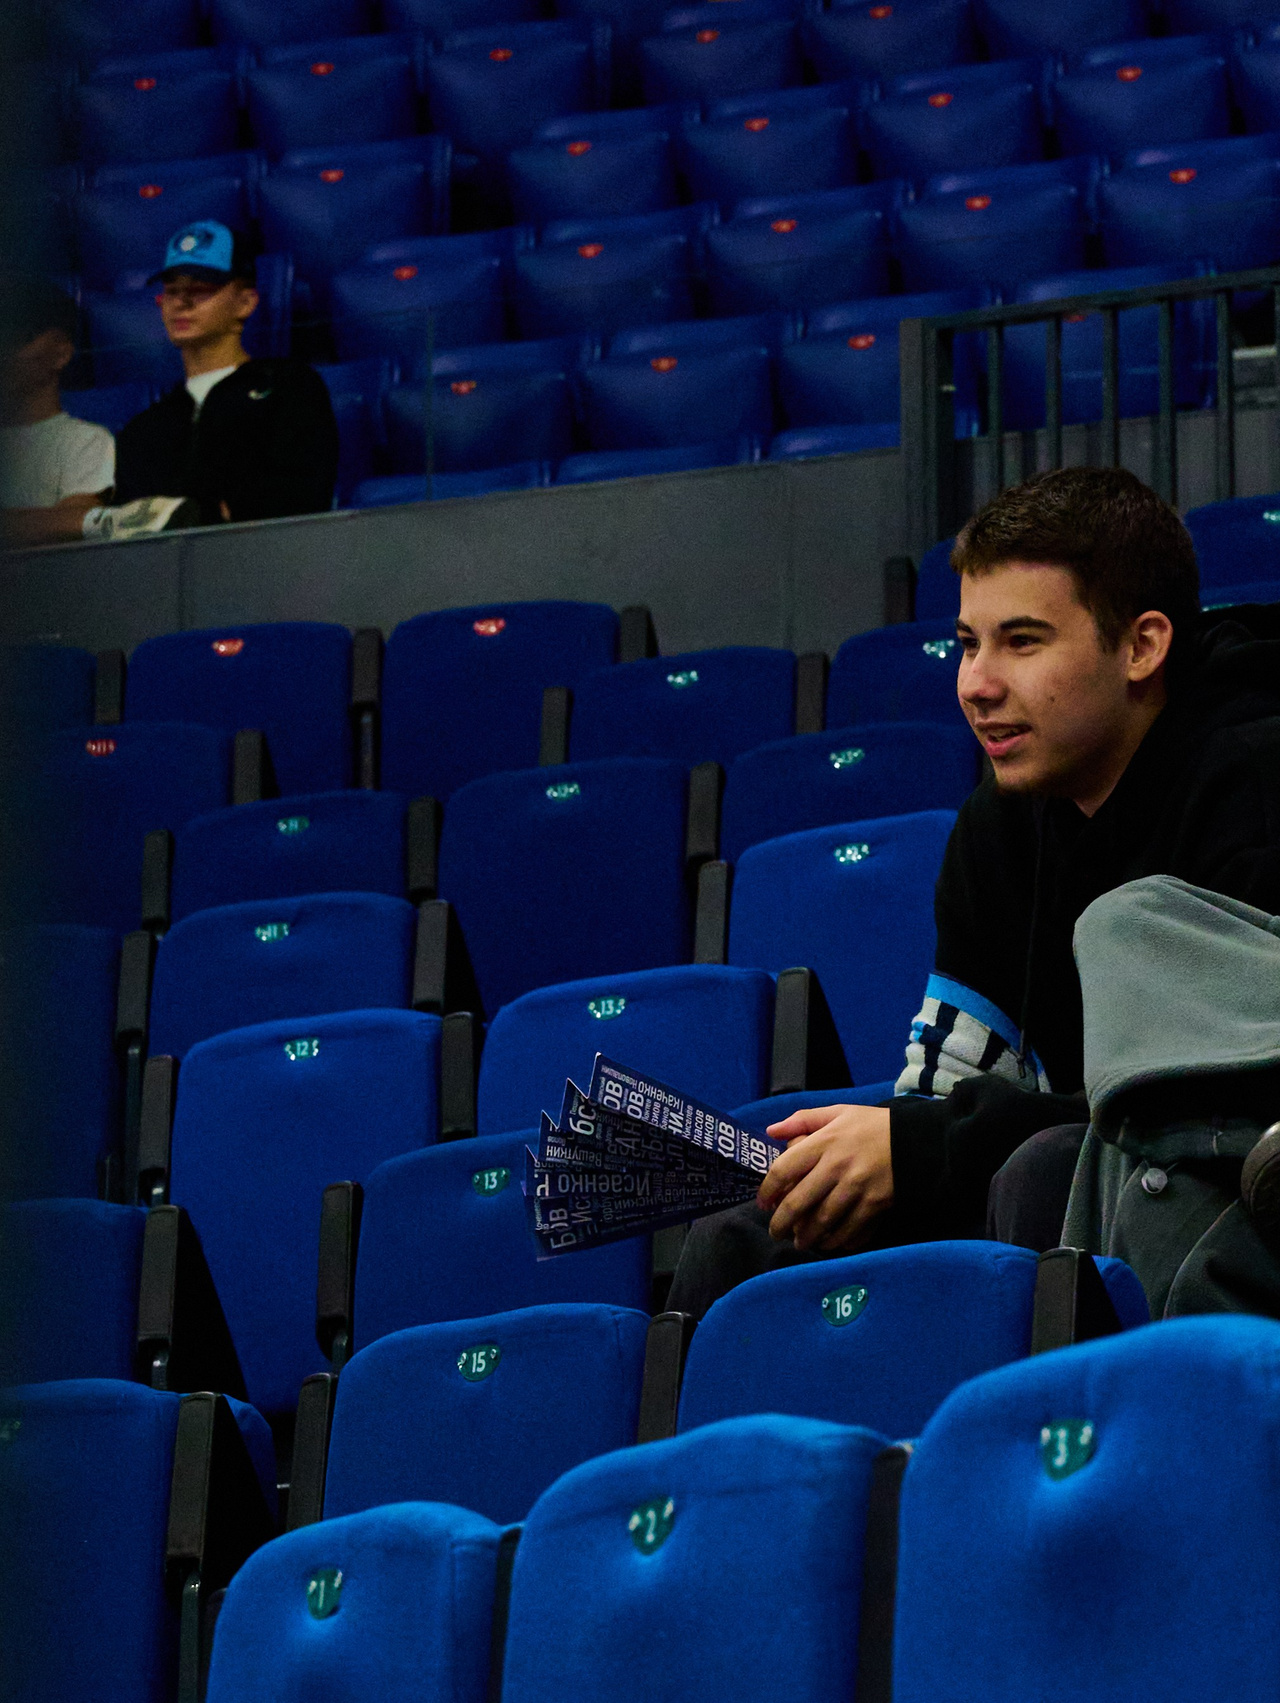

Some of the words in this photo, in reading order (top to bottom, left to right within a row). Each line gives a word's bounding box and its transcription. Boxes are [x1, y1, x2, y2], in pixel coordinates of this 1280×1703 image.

[601, 999, 615, 1016] 13
[296, 1041, 309, 1056] 12
[638, 1081, 684, 1117] Ткаченко
[546, 1145, 602, 1168] Вешуткин
[485, 1172, 498, 1190] 13
[557, 1173, 650, 1197] Исаенко
[835, 1294, 852, 1319] 16
[472, 1352, 486, 1373] 15
[646, 1509, 657, 1544] 2
